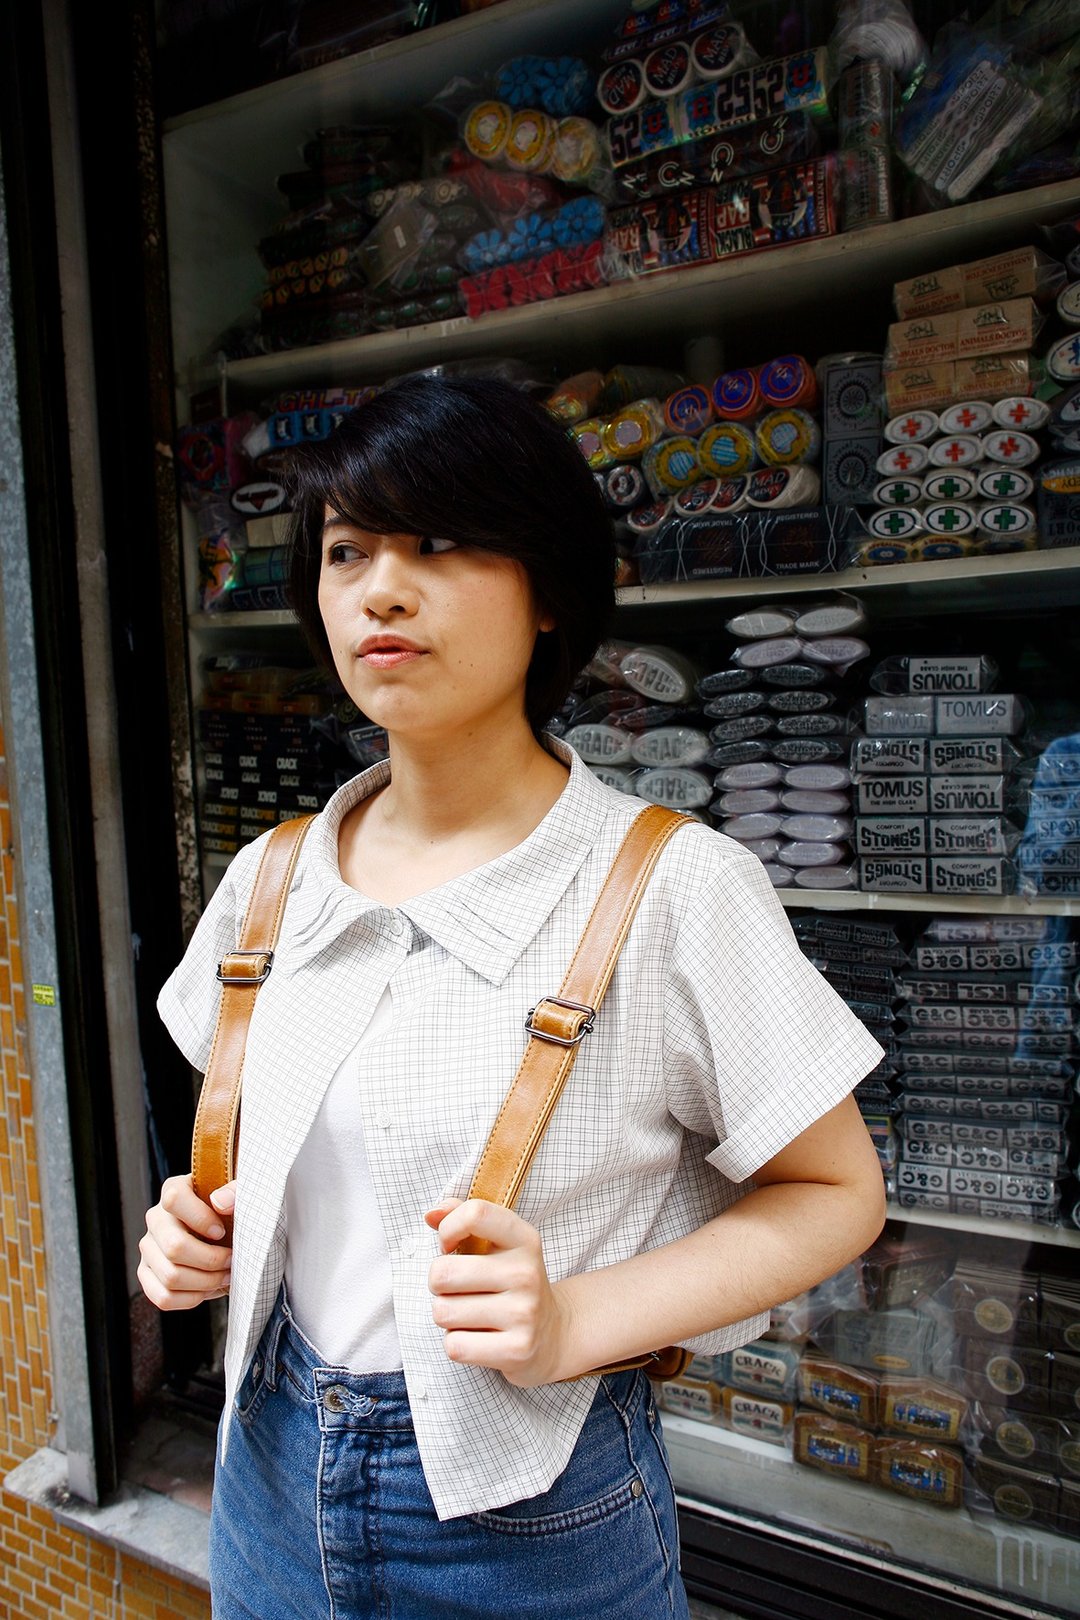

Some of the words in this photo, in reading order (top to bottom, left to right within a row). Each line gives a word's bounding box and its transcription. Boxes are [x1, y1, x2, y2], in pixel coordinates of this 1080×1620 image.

[702, 29, 728, 64] MAD
[653, 47, 678, 84] MAD
[608, 68, 637, 105] MAD
[716, 201, 751, 229] RAP
[960, 335, 994, 346] ANIMALS
[754, 470, 787, 487] MAD
[776, 511, 820, 522] REGISTERED
[692, 567, 733, 575] REGISTERED
[776, 561, 798, 570] TRADE
[799, 560, 820, 569] MARK
[912, 673, 977, 690] TOMUS
[942, 699, 1007, 717] TOMUS
[862, 780, 923, 798] TOMUS
[934, 792, 999, 809] TOMUS
[1028, 945, 1071, 960] G&C
[922, 954, 963, 968] G&C
[975, 953, 1017, 967] G&C
[958, 985, 1005, 999] KSL
[1019, 985, 1067, 999] KSL
[915, 1008, 957, 1021] G&C
[967, 1014, 1011, 1027] G&C
[1023, 1016, 1067, 1027] G&C
[967, 1035, 1011, 1047] G&C
[1023, 1036, 1067, 1047] G&C
[907, 1055, 948, 1067] G&C
[958, 1057, 1001, 1069] G&C
[1013, 1060, 1057, 1071] G&C
[911, 1077, 953, 1088] G&C
[961, 1079, 1004, 1090] G&C
[1016, 1081, 1060, 1092] G&C
[908, 1098, 949, 1110] G&C
[985, 1104, 1028, 1115] G&C
[911, 1122, 952, 1136] G&C
[908, 1140, 948, 1156] G&C
[1012, 1136, 1056, 1149] G&C
[960, 1151, 1002, 1168] G&C
[902, 1171, 943, 1188] G&C
[955, 1178, 997, 1194] G&C
[1006, 1183, 1049, 1200] G&C
[904, 1193, 945, 1207] G&C
[735, 1355, 781, 1377] CRACK
[664, 1385, 706, 1404] CRACK
[735, 1401, 780, 1423] CRACK
